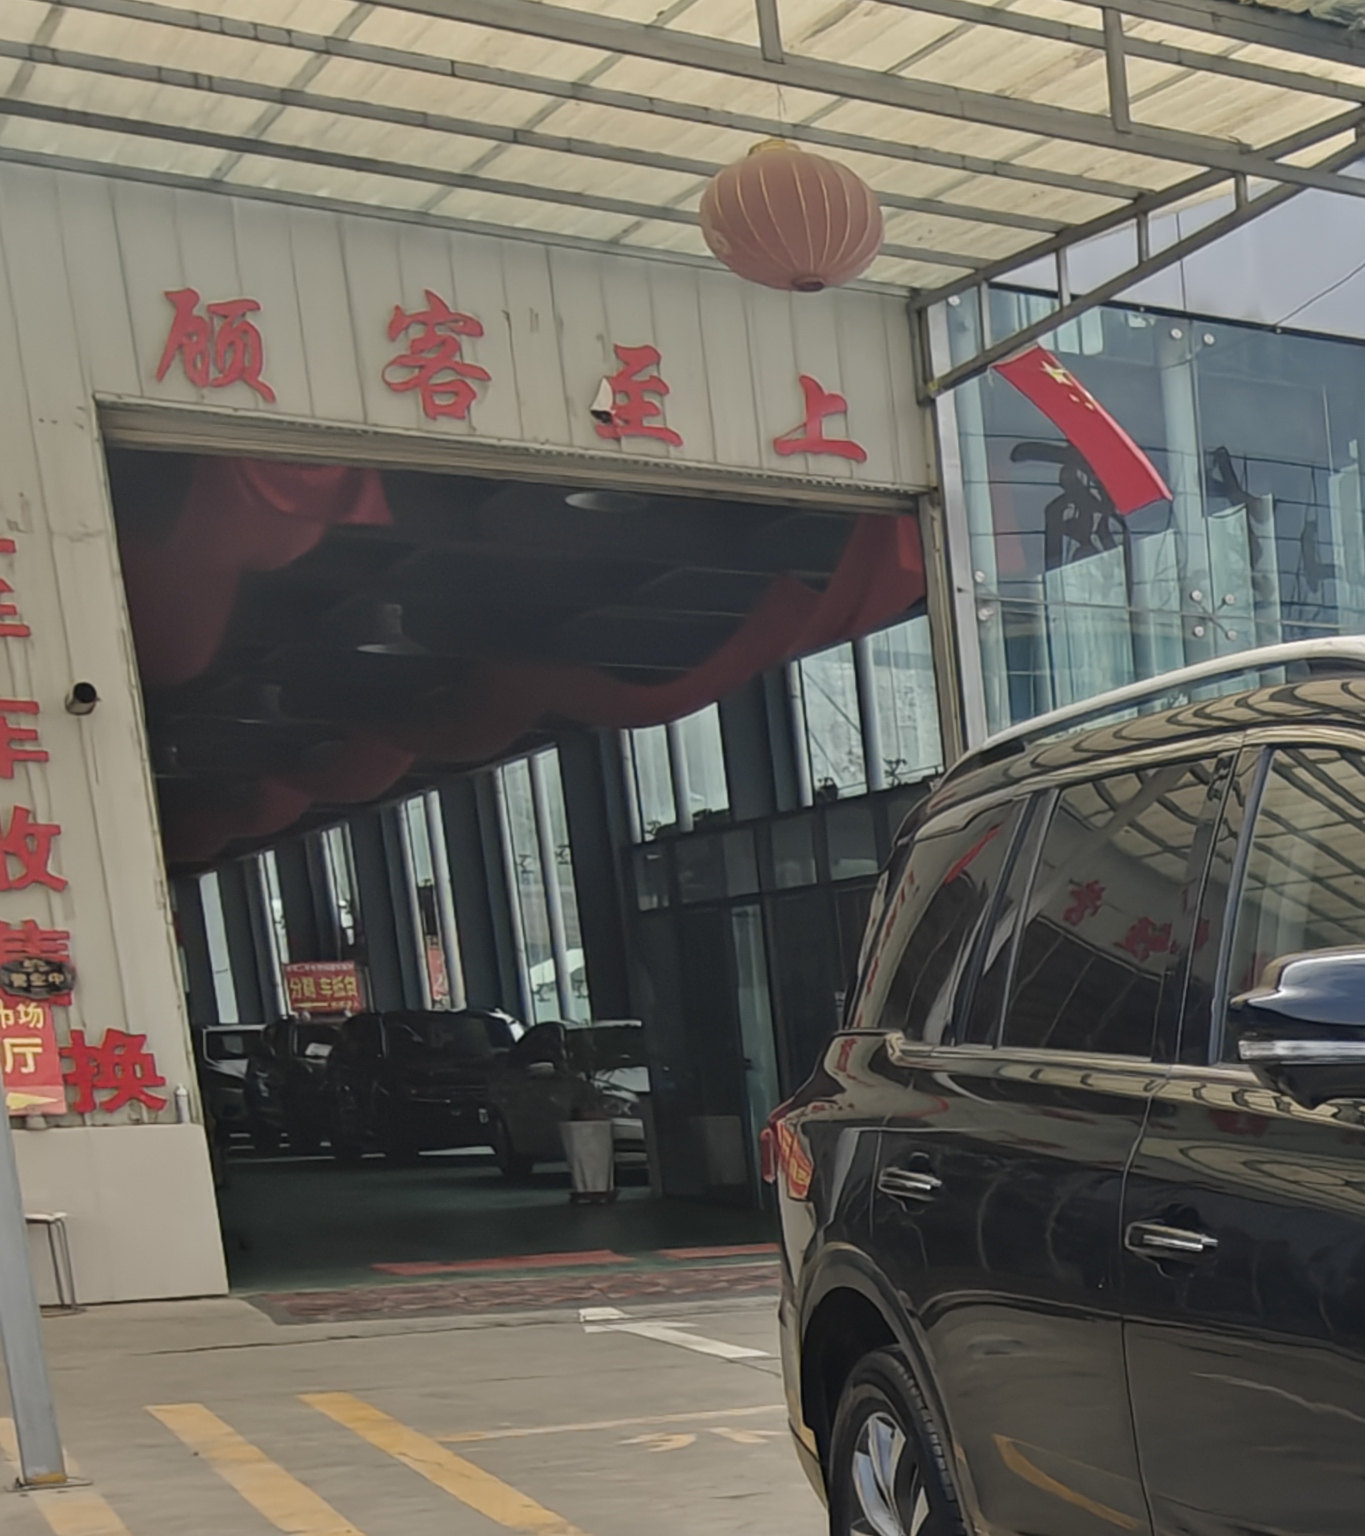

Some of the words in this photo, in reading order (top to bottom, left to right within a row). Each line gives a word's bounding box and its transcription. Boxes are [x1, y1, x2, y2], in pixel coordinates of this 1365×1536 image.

[156, 288, 868, 464] 顾客至上
[58, 1028, 168, 1114] 换
